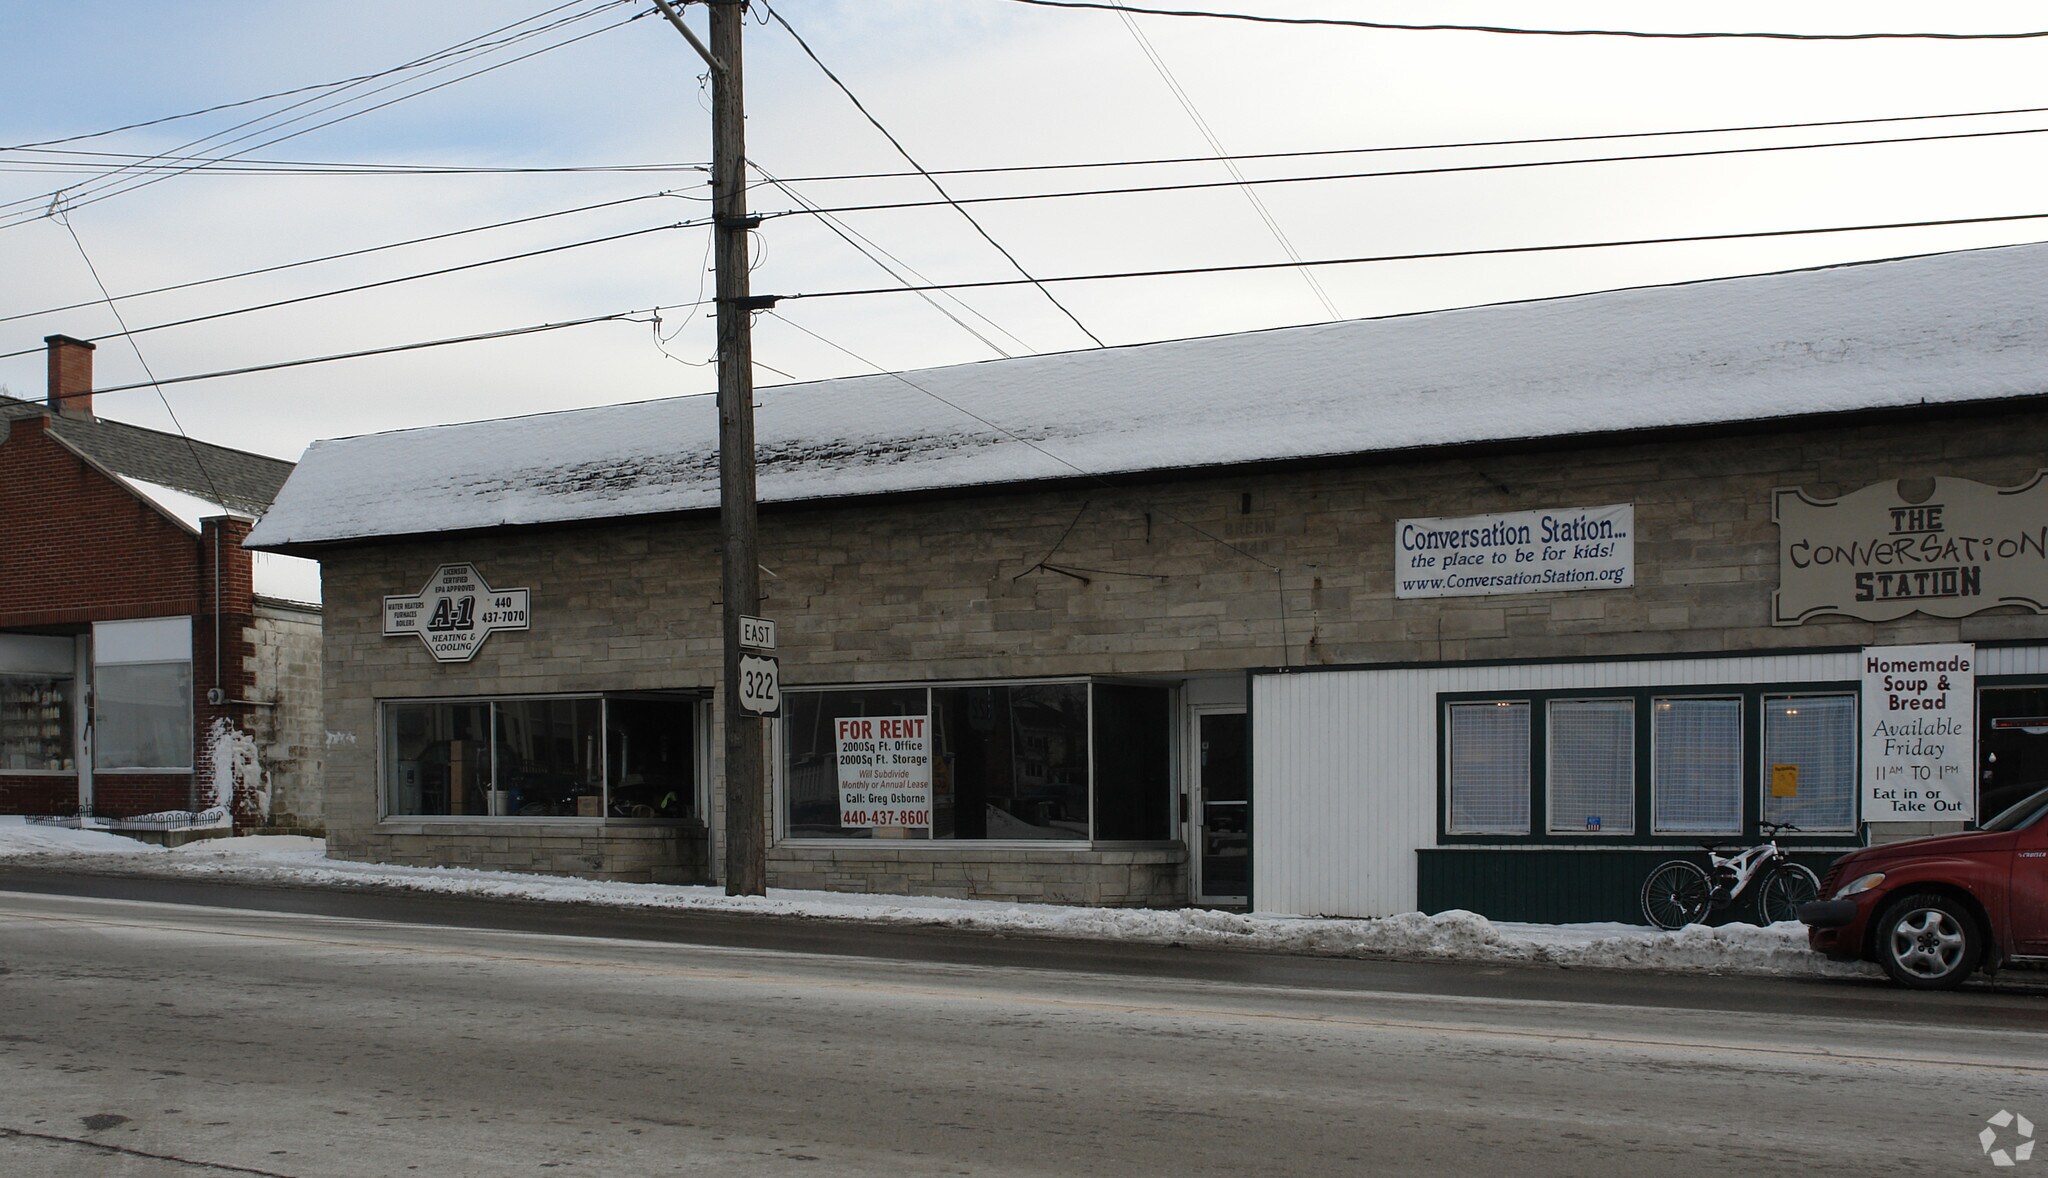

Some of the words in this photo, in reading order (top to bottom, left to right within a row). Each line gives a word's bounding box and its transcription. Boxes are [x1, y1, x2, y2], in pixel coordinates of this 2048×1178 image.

[1890, 507, 1943, 531] THE
[1402, 520, 1531, 551] Conversation
[1541, 515, 1626, 544] Station...
[1411, 553, 1436, 568] the
[1442, 552, 1485, 571] place
[1491, 551, 1507, 565] to
[1514, 549, 1535, 563] be
[1541, 546, 1566, 561] for
[1573, 543, 1615, 560] kids!
[443, 567, 468, 576] LICENSED
[1402, 566, 1625, 591] www.ConversationStation.org
[442, 576, 469, 584] CERTIFIED
[1855, 566, 1980, 601] STATION
[435, 585, 445, 593] EPA
[446, 584, 476, 593] APPROVED
[494, 597, 512, 608] 440
[394, 610, 417, 619] FURNACES
[427, 595, 476, 631] A-1
[481, 610, 525, 623] 437-7070
[396, 619, 415, 627] BOILERS
[432, 633, 467, 642] HEATING
[470, 633, 476, 641] &
[744, 624, 770, 643] EAST
[435, 642, 472, 651] COOLING
[1867, 655, 1970, 673] Homemade
[745, 670, 774, 700] 322
[1884, 675, 1928, 695] Soup
[1937, 675, 1951, 691] &
[1889, 693, 1946, 711] Bread
[839, 720, 872, 740] FOR
[880, 719, 925, 739] RENT
[1873, 717, 1962, 737] Available
[842, 741, 875, 754] 2000Sq
[879, 741, 891, 751] Ft.
[894, 740, 923, 751] Office
[1884, 738, 1945, 760] Friday
[840, 755, 873, 767] 2000Sq
[876, 754, 888, 765] Ft.
[892, 754, 927, 767] Storage
[859, 769, 872, 779] Will
[874, 769, 909, 779] Subdivide
[1911, 765, 1931, 780] TO
[842, 780, 870, 791] Monthly
[880, 780, 906, 789] Annual
[907, 779, 929, 789] Lease
[846, 794, 866, 804] Call:
[868, 793, 888, 806] Greg
[891, 793, 926, 804] Osborne
[1873, 788, 1896, 799] Eat
[1903, 788, 1917, 799] in
[1925, 790, 1941, 799] or
[1891, 800, 1926, 812] Take
[1933, 800, 1962, 812] Out
